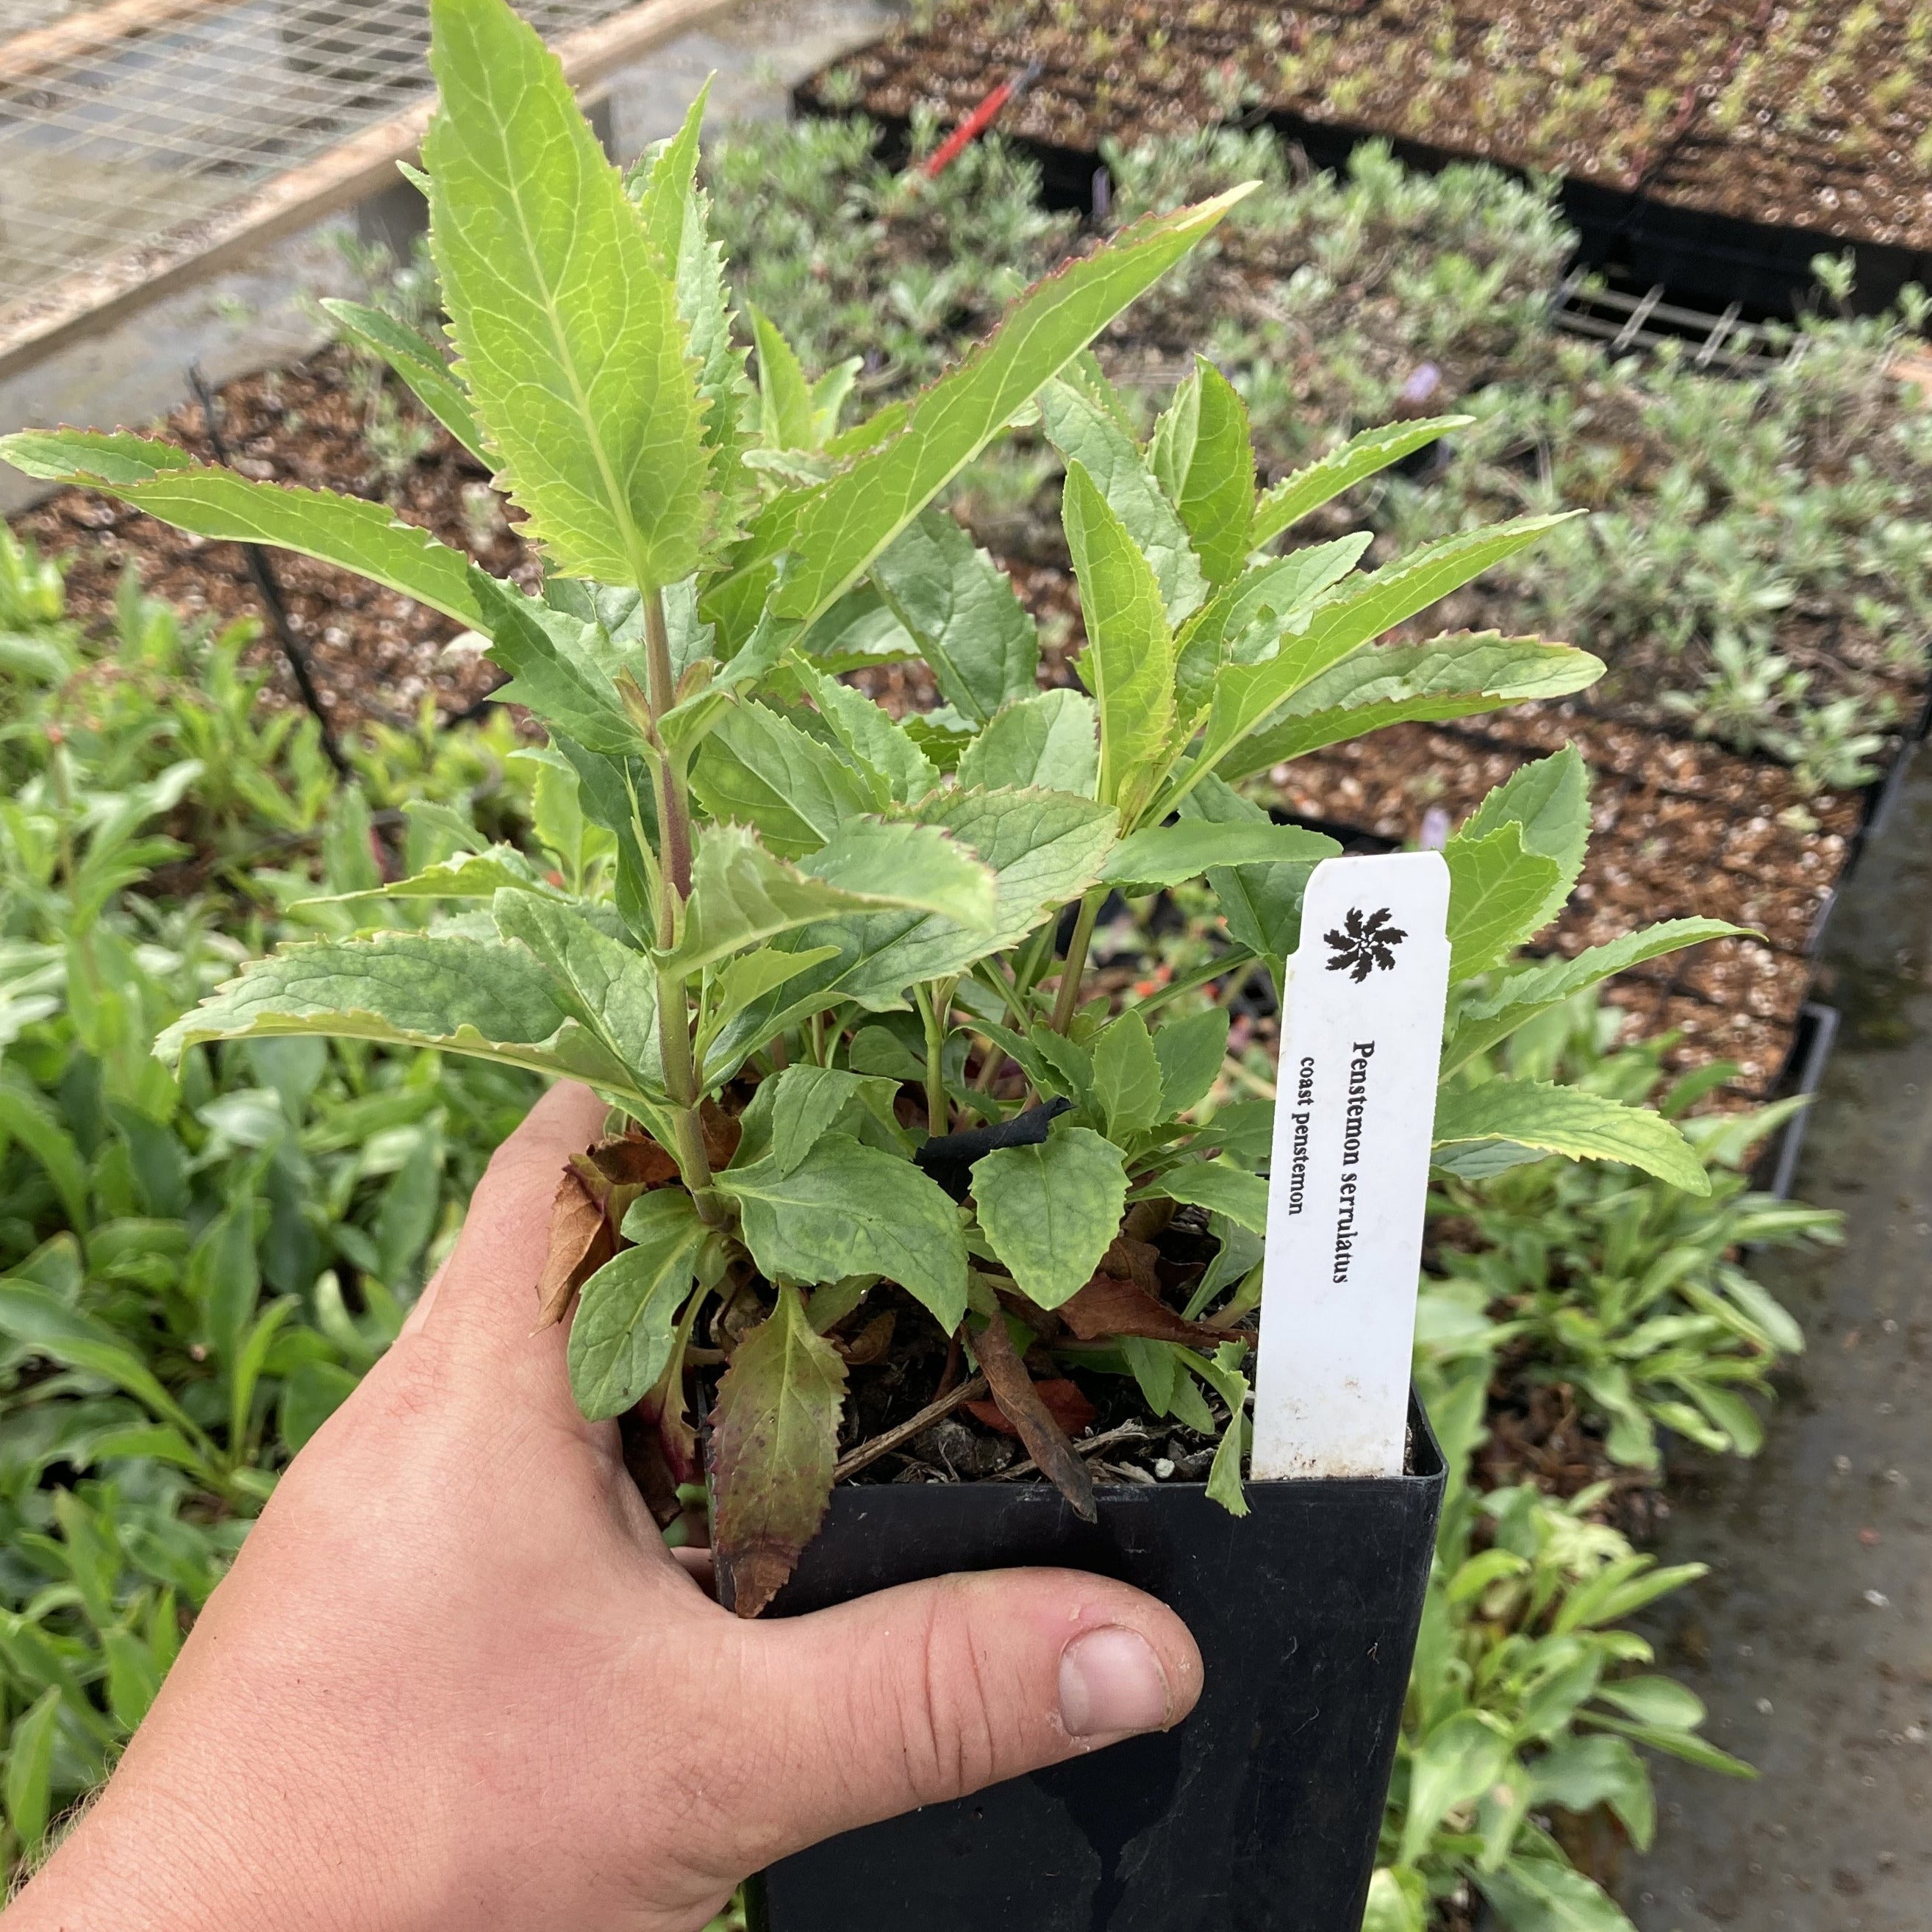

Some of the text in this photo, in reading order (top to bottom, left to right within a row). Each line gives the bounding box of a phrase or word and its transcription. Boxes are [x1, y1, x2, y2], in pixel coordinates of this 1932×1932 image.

[1288, 1056, 1315, 1216] coast penstemon
[1332, 1040, 1375, 1284] Penstemon serrulatus
